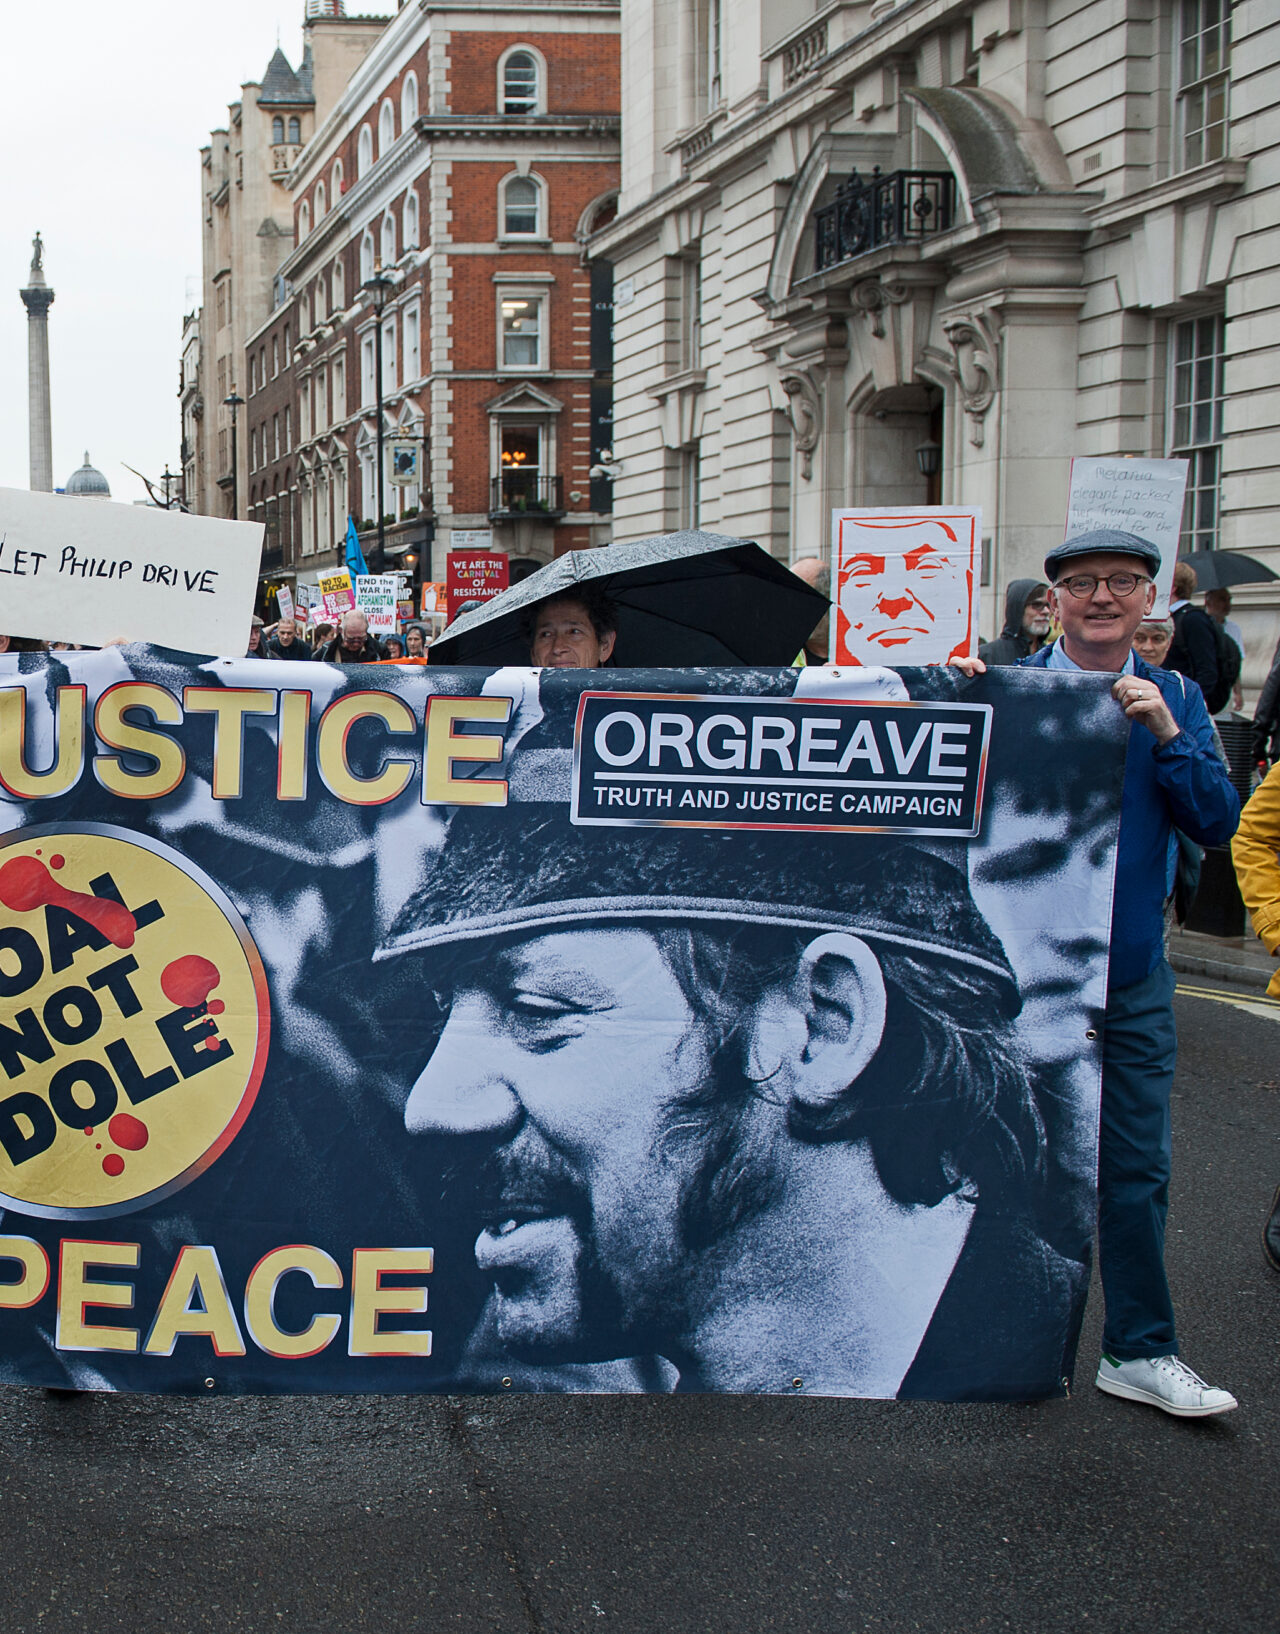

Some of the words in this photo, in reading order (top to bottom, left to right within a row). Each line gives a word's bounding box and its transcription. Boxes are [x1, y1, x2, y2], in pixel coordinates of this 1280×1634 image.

[59, 545, 132, 579] PHILIP
[142, 563, 219, 593] DRIVE
[453, 561, 467, 570] WE
[469, 561, 486, 569] ARE
[488, 561, 503, 569] THE
[457, 570, 500, 578] CARNIVAL
[358, 578, 377, 586] END
[379, 578, 394, 586] the
[472, 579, 486, 587] OF
[359, 586, 380, 594] WAR
[383, 586, 391, 594] in
[453, 588, 503, 597] RESISTANCE
[357, 595, 394, 606] AFGHANISTAN
[594, 711, 972, 778] ORGREAVE
[593, 786, 673, 808] TRUTH
[678, 789, 730, 810] AND
[735, 791, 833, 813] JUSTICE
[840, 794, 962, 817] CAMPAIGN
